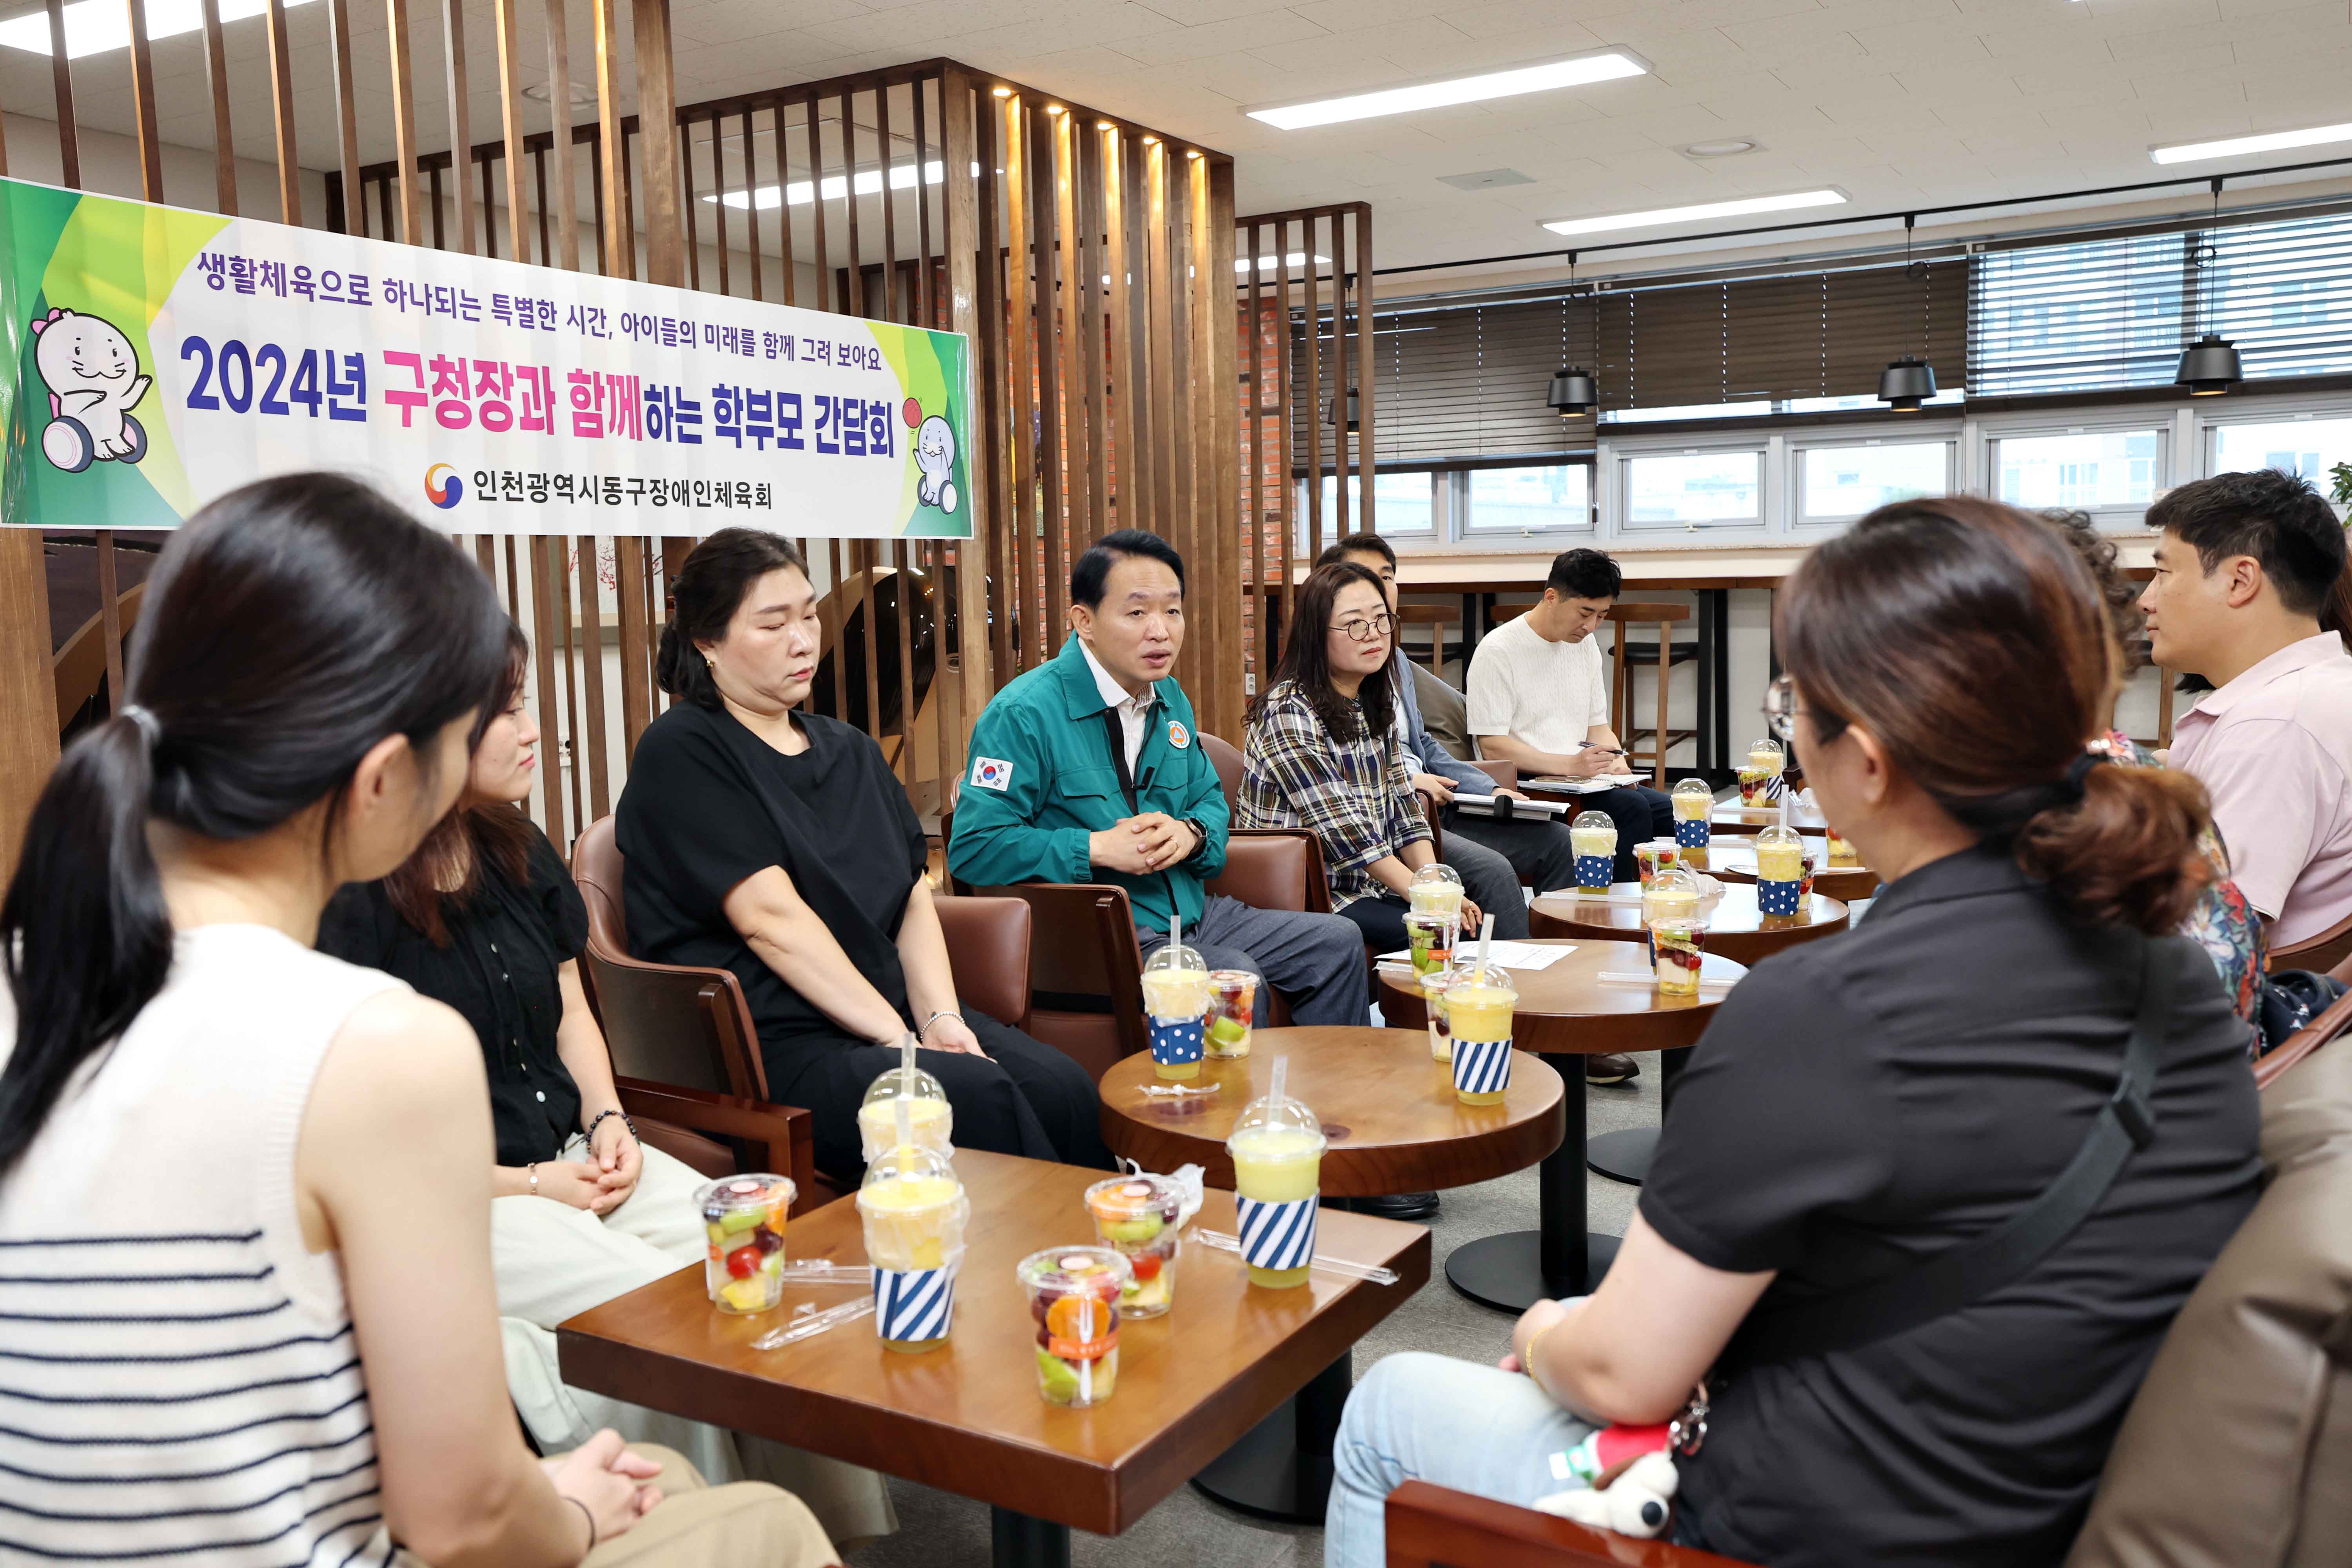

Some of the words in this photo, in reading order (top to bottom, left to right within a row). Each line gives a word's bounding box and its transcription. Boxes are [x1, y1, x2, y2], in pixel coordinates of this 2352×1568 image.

[197, 251, 372, 306] 생활체육으로
[383, 278, 481, 322] 하나되는
[492, 294, 557, 331] 특별한
[567, 305, 612, 339] 시간,
[621, 313, 696, 348] 아이들의
[705, 325, 755, 357] 미래를
[763, 332, 794, 361] 함께
[802, 339, 830, 366] 그려
[837, 343, 882, 370] 보아요
[181, 336, 366, 422] 2024년
[383, 350, 555, 435] 구청장과
[568, 368, 702, 444] 함께하는
[712, 383, 804, 450] 학부모
[815, 395, 893, 458] 간담회
[474, 471, 771, 509] 인천광역시동구장애인체육회
